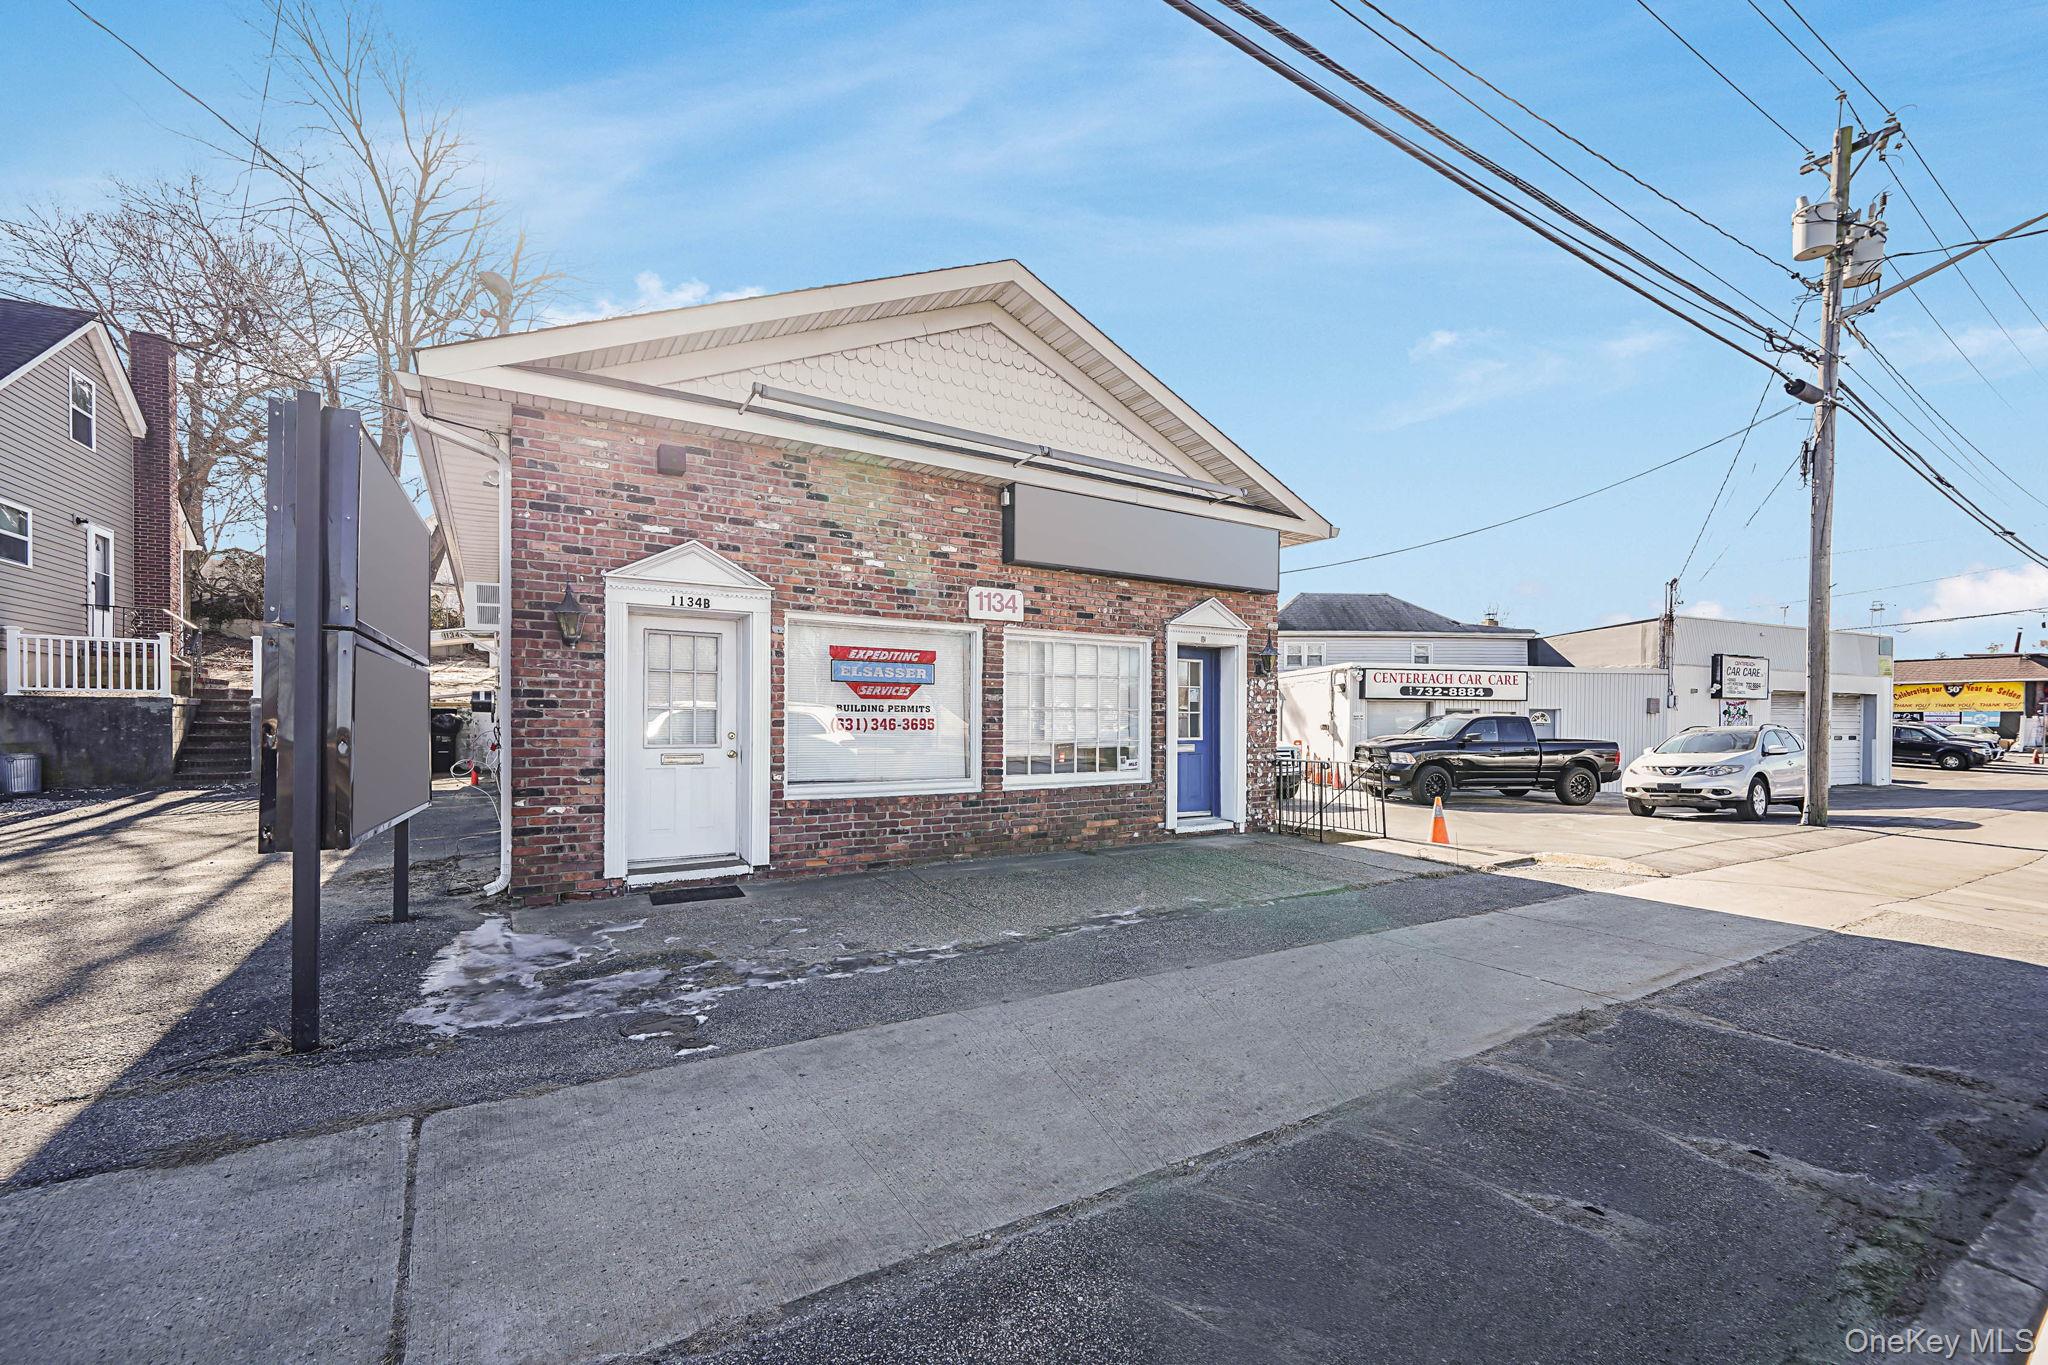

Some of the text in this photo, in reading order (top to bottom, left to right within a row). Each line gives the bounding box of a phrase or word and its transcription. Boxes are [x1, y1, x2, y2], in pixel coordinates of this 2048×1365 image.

[670, 595, 711, 609] 1134B
[975, 591, 1018, 613] 1134
[848, 649, 921, 662] EXPEDITING
[840, 665, 927, 679] ELSASSER
[1373, 671, 1519, 686] CENTEREACH CAR CARE
[1727, 666, 1760, 677] CAR CARE
[857, 685, 911, 696] SERVICES
[1416, 687, 1485, 697] 732-8884
[1893, 687, 1930, 700] Celebrating
[1966, 684, 1983, 692] Year
[1985, 685, 1993, 693] in
[1997, 687, 2021, 699] Selden
[836, 704, 931, 713] BUILDING PERMITS
[870, 717, 935, 731] 346-3695
